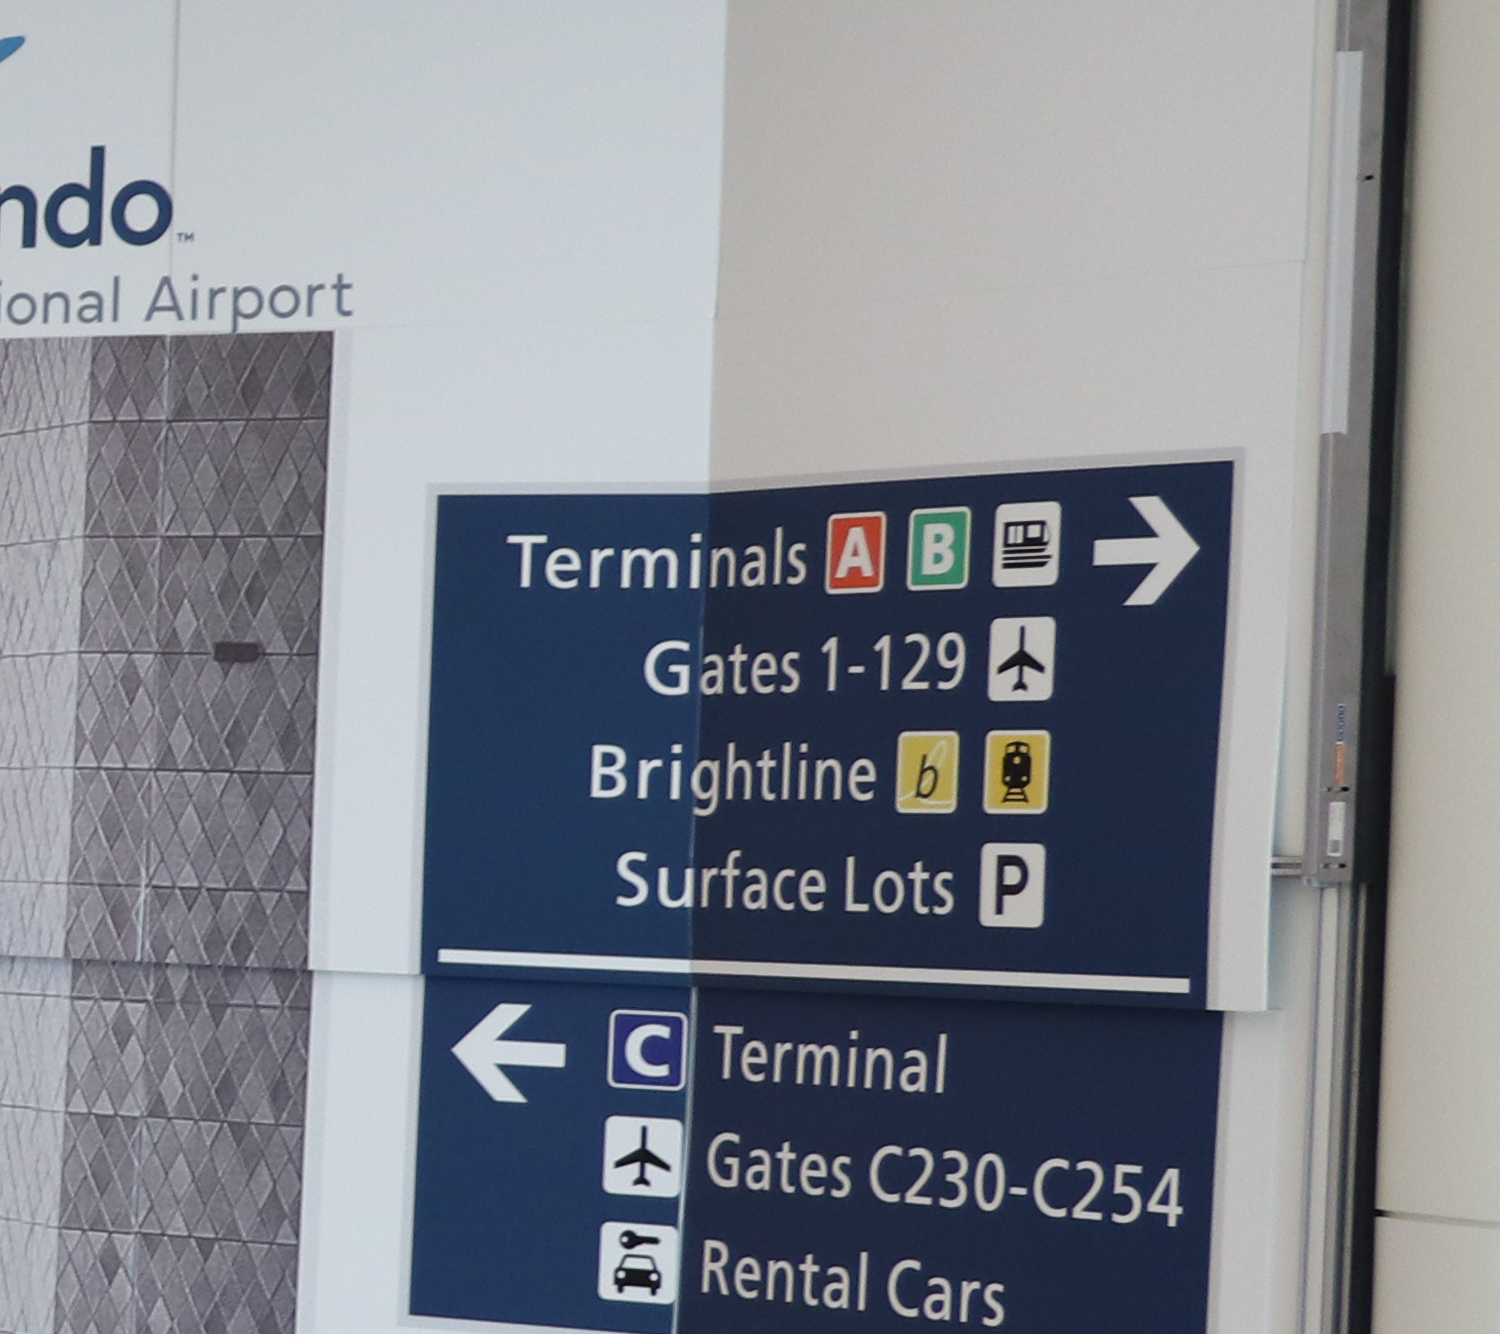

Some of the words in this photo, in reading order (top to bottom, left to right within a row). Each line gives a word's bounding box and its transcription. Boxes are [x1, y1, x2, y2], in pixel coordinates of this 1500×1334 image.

[145, 273, 353, 333] Airport
[506, 526, 807, 589] Terminals
[835, 526, 874, 580] A
[921, 522, 956, 575] B
[644, 640, 801, 696] Gates
[821, 632, 966, 692] 1-129
[591, 742, 877, 816] Brightline
[615, 850, 827, 912] Surface
[845, 857, 955, 915] Lots
[995, 854, 1029, 915] P
[624, 1023, 671, 1077] C
[714, 1025, 947, 1094] Terminal
[707, 1132, 851, 1199] Gates
[869, 1144, 1184, 1228] C230-C254
[702, 1240, 867, 1311] Rental
[888, 1259, 1005, 1328] Cars
